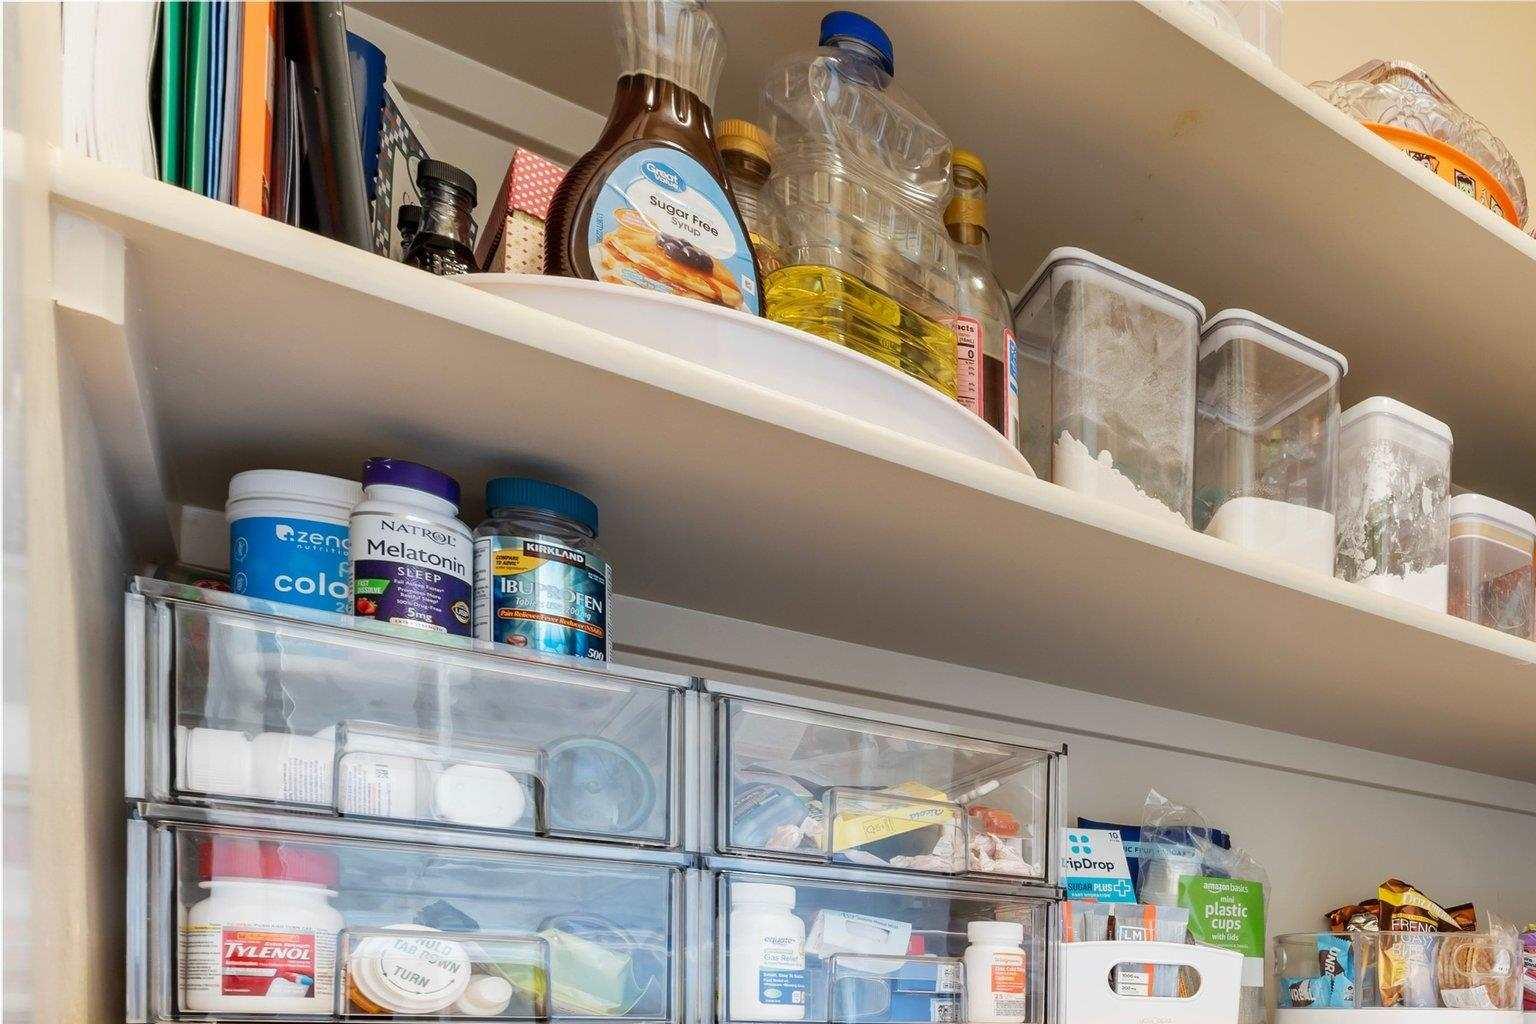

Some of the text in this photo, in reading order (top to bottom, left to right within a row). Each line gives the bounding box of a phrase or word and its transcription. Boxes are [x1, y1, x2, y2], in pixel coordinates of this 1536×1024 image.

[646, 162, 679, 185] Great
[650, 195, 720, 238] Sugar Free
[671, 216, 702, 238] Syrup
[381, 519, 456, 548] NATROL
[366, 538, 466, 577] Melatonin
[526, 542, 584, 563] KIRKLAND
[397, 567, 442, 584] SLEEP
[407, 607, 433, 622] 5mg
[587, 648, 605, 661] 500
[1108, 831, 1119, 840] 10
[1067, 882, 1113, 893] SUGAR PLUS
[1203, 882, 1249, 894] amazon basics
[1220, 896, 1235, 904] mini
[1205, 904, 1249, 920] plastic
[1211, 917, 1242, 932] cups
[1211, 933, 1226, 941] with
[224, 941, 312, 960] TYLENOL
[393, 939, 419, 956] TAB
[391, 964, 432, 988] TURN
